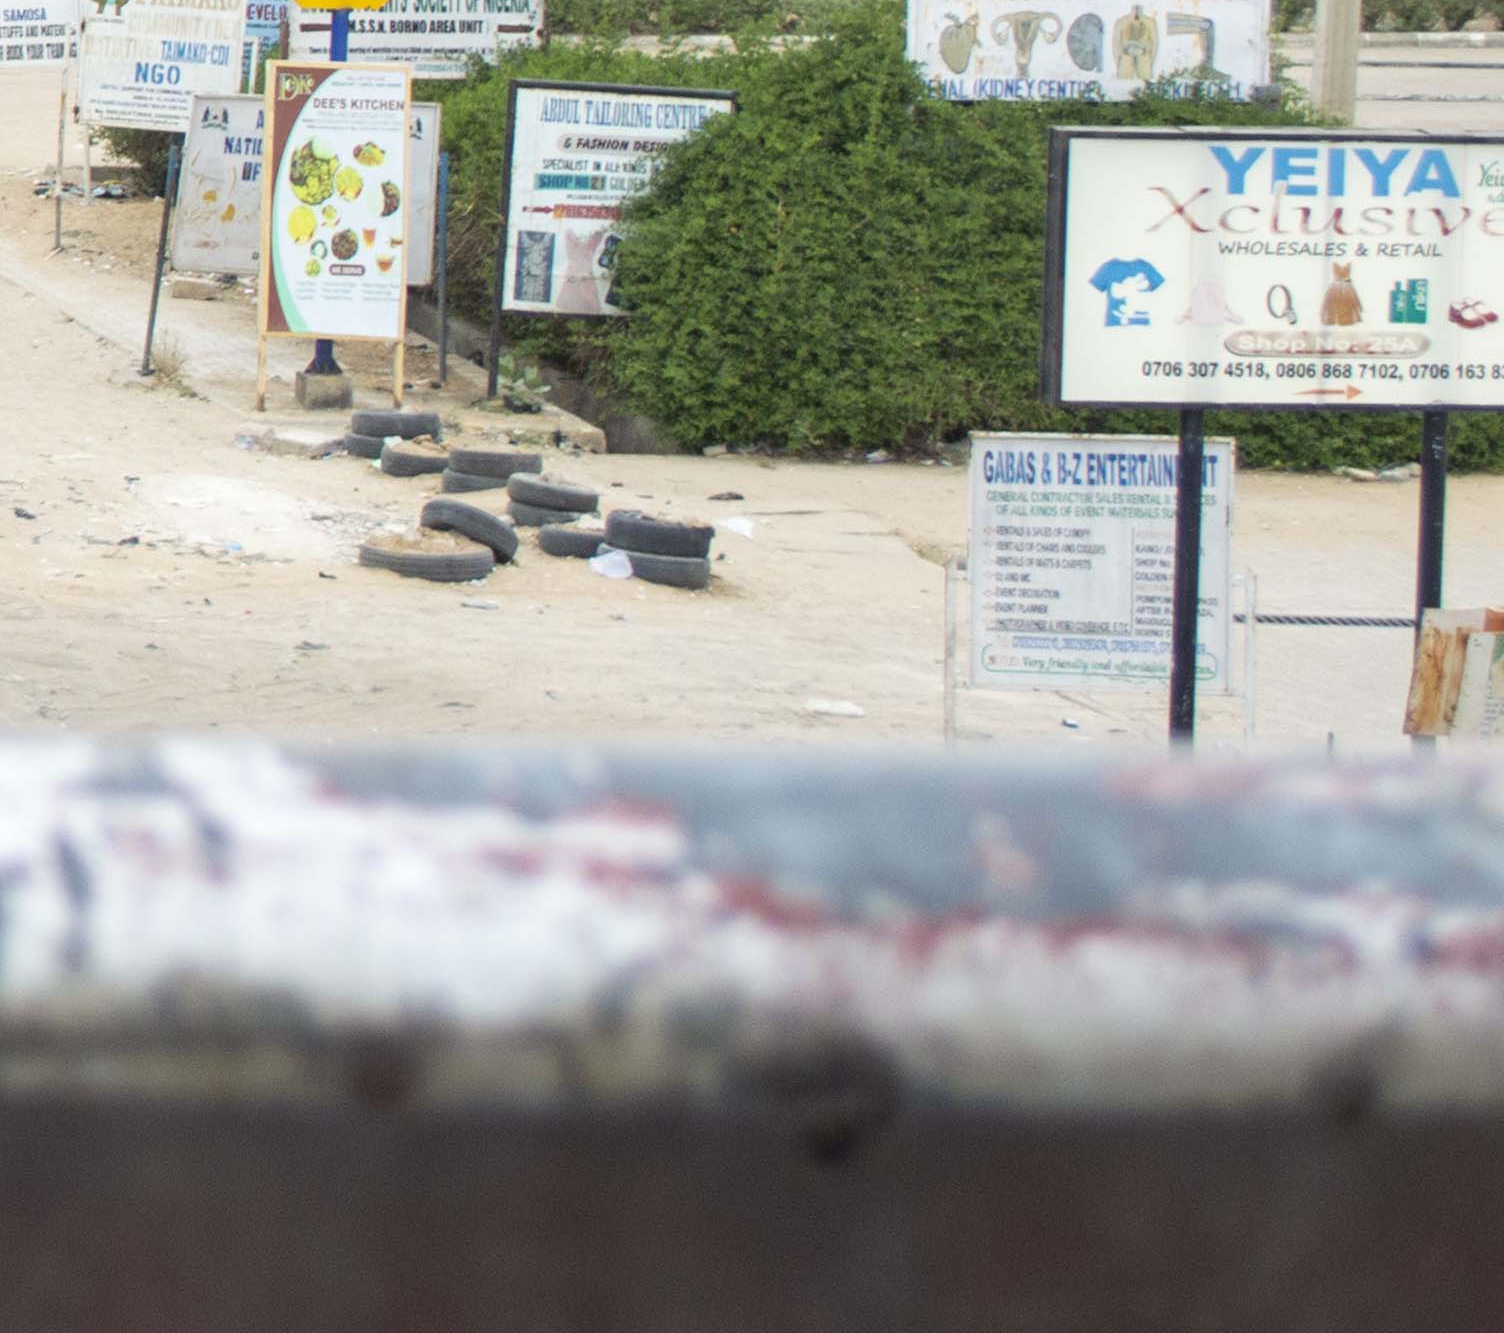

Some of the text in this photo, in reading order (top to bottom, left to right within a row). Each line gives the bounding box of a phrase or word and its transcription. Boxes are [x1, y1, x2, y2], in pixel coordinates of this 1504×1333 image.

[3, 8, 47, 21] SAMOSA
[390, 20, 483, 34] BORNO AREA UNIT
[135, 61, 181, 85] NGO
[973, 78, 1033, 99] (KIDNEY
[313, 98, 404, 111] DEE'S KITCHEN
[540, 97, 706, 129] ABDUL TAILORING CENTRE
[576, 138, 628, 151] FASHION
[542, 159, 588, 170] SPECIALIST
[1209, 145, 1461, 198] YEIYA
[538, 174, 571, 188] SHOP
[1218, 241, 1443, 258] WHOLESALES & RETAIL
[1238, 335, 1420, 353] Shop No: 25A
[1142, 361, 1485, 381] 0706 307 4518, 0806 868 7102, 0706 163
[983, 450, 1082, 485] GABAS & B-Z
[987, 491, 1161, 505] GENERAL CONTRACTOR SALES RENTAL
[996, 504, 1160, 519] OF ALL KINDS OF EVENT MATERIALS
[1022, 656, 1045, 670] Very
[1047, 656, 1089, 672] friendly
[1091, 659, 1111, 670] and
